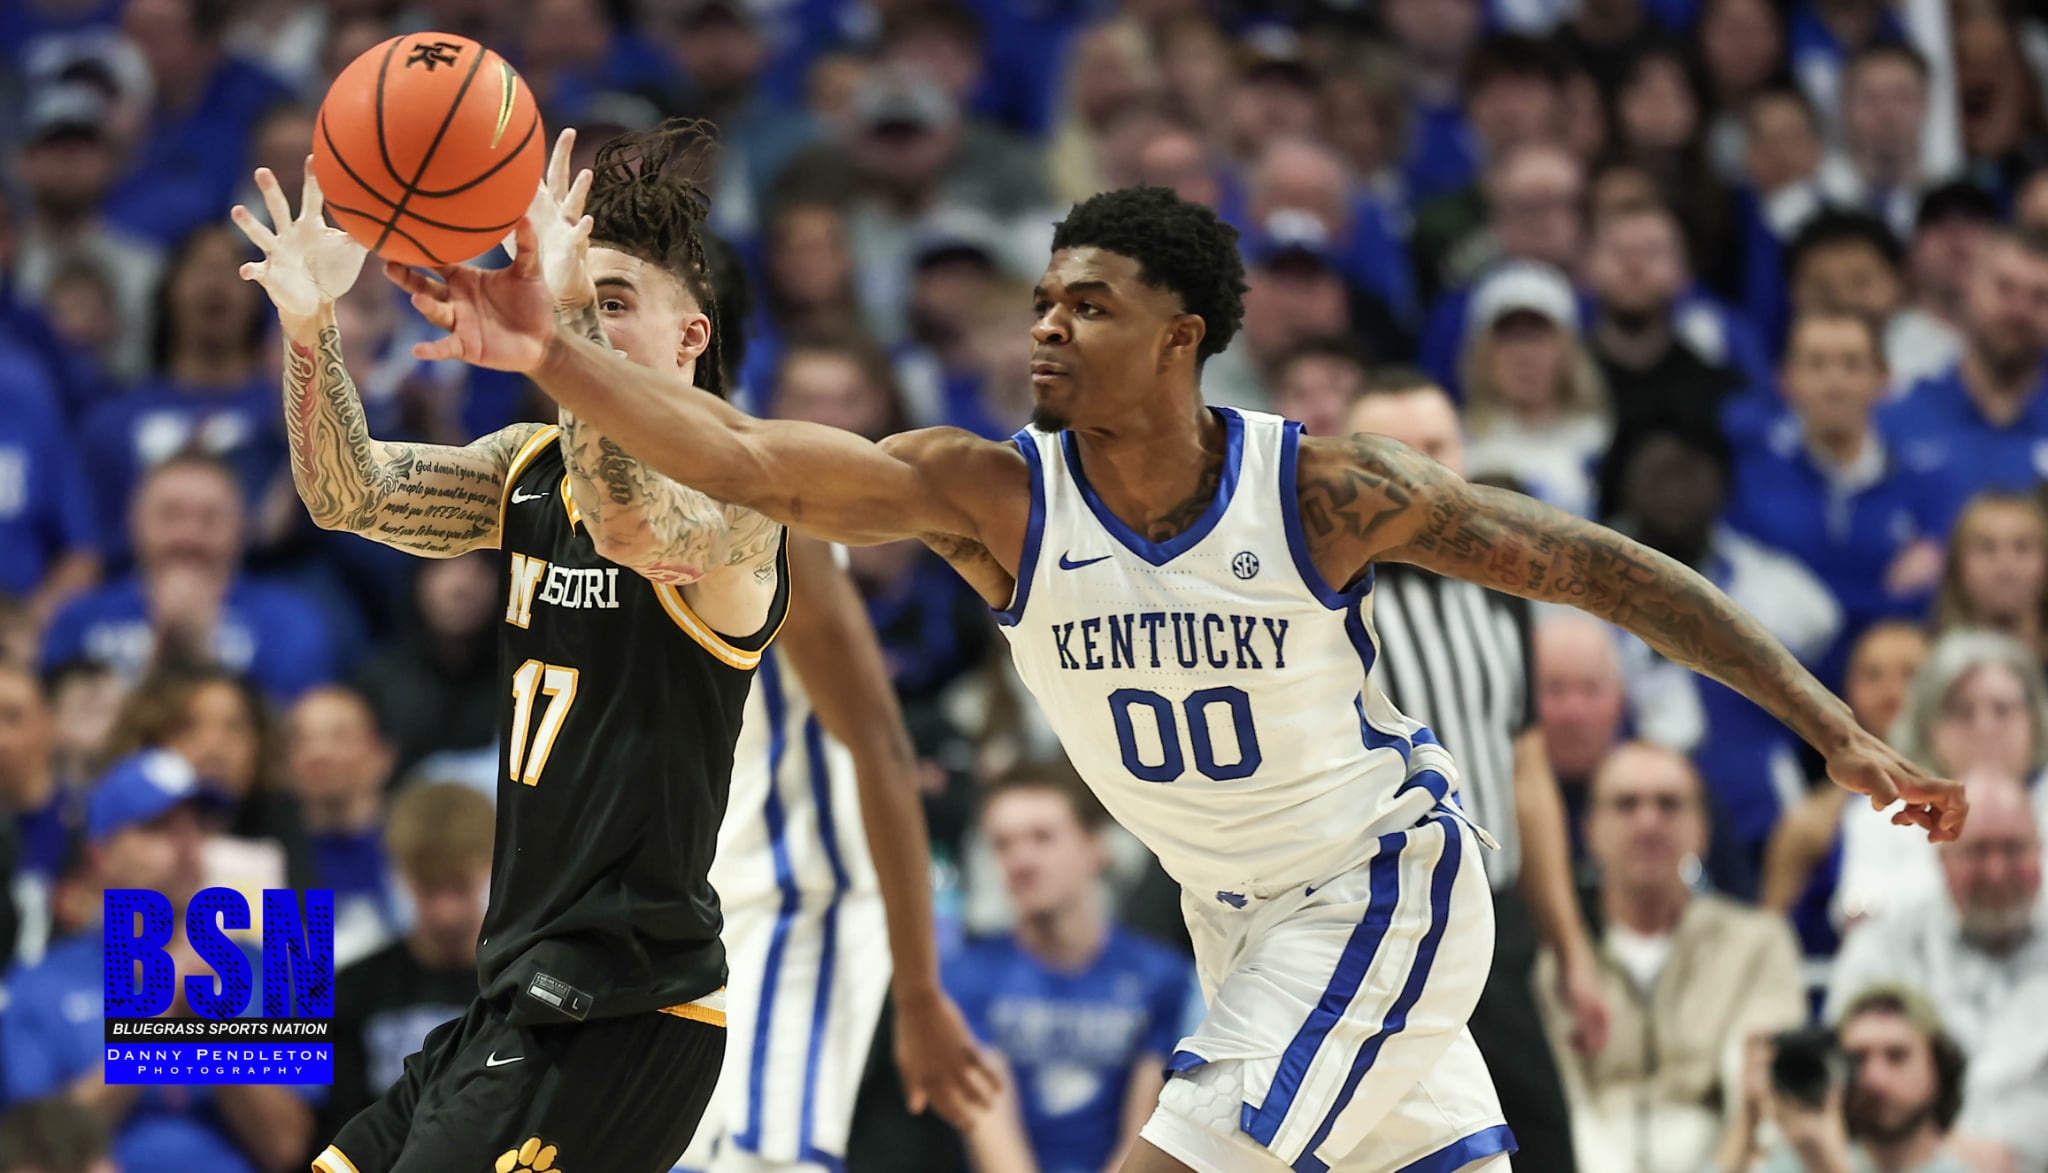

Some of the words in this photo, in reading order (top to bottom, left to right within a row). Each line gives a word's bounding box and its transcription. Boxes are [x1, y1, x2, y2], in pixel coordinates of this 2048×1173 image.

[398, 481, 423, 496] people
[416, 460, 432, 475] God
[1052, 612, 1288, 670] KENTUCKY
[509, 658, 580, 787] 17
[1107, 685, 1263, 783] 00
